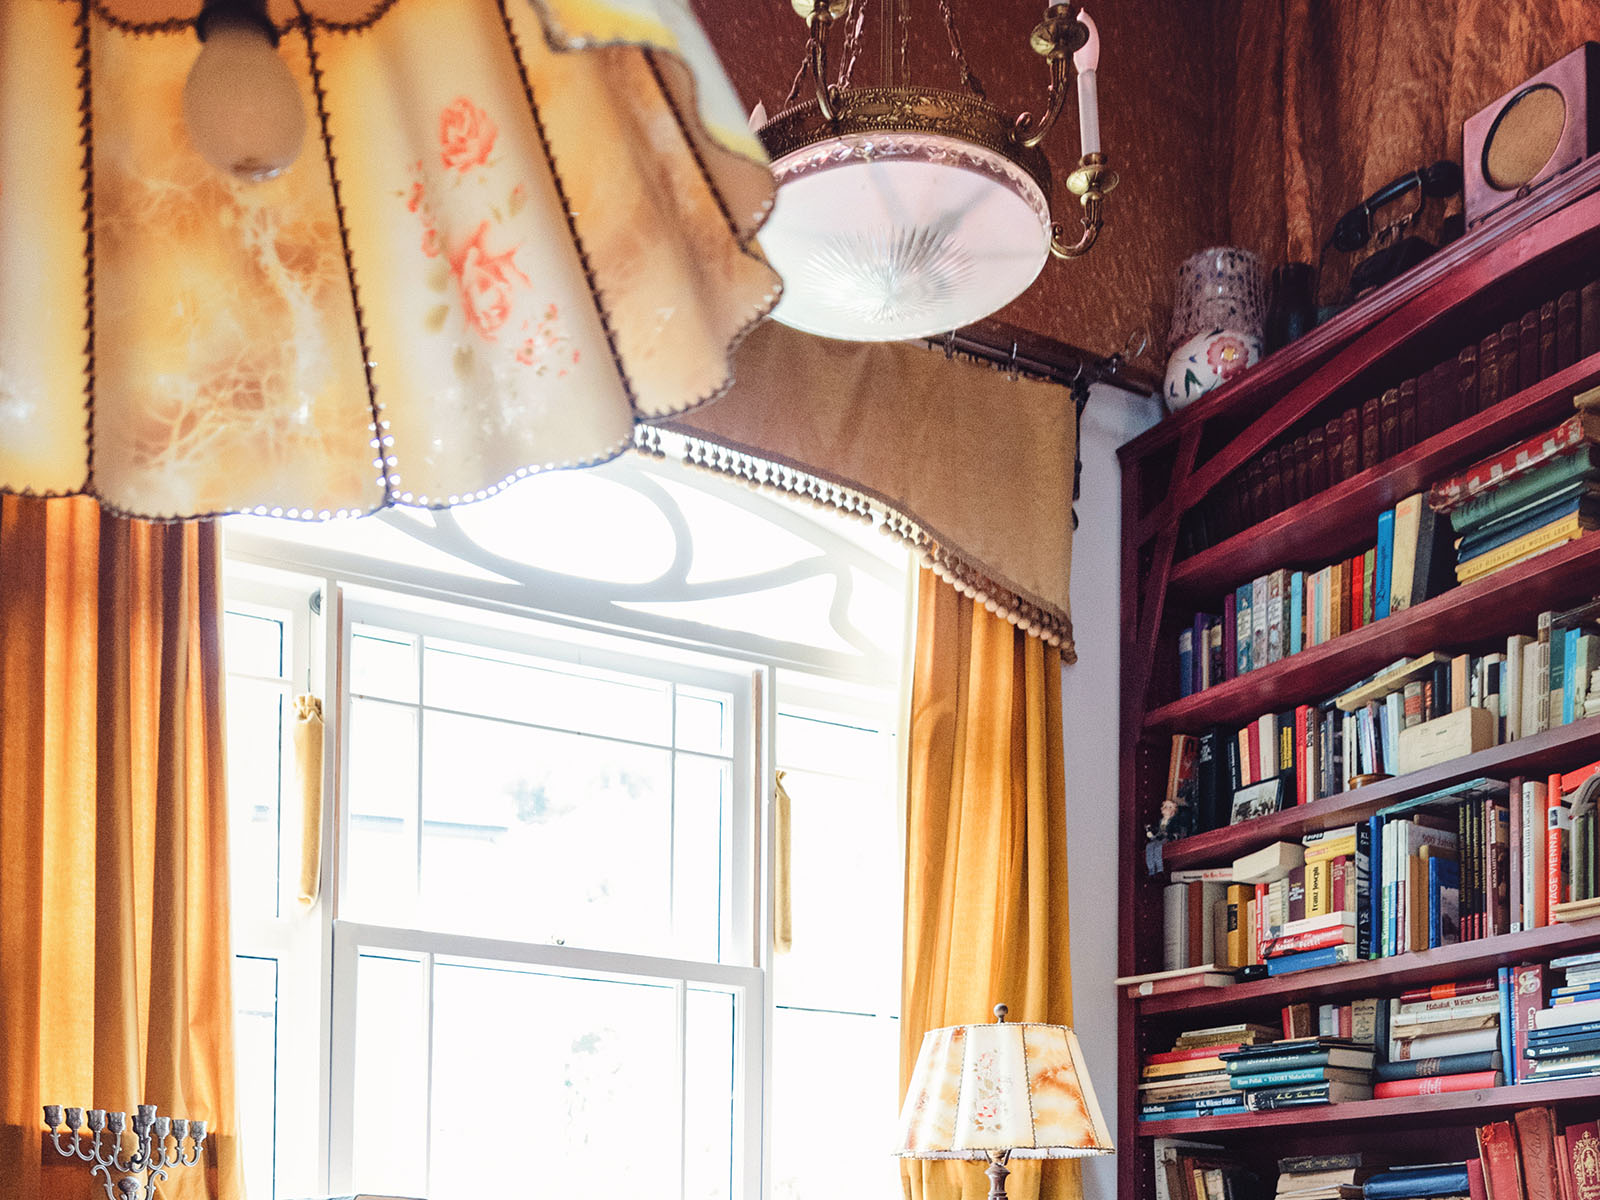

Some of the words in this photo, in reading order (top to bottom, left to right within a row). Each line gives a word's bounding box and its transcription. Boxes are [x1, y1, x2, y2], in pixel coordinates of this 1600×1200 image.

[1549, 832, 1558, 874] VIENNA
[1312, 866, 1320, 892] Joseph
[1311, 893, 1319, 912] Franz
[1549, 877, 1558, 926] VITAGE
[1453, 996, 1474, 1007] Wiener
